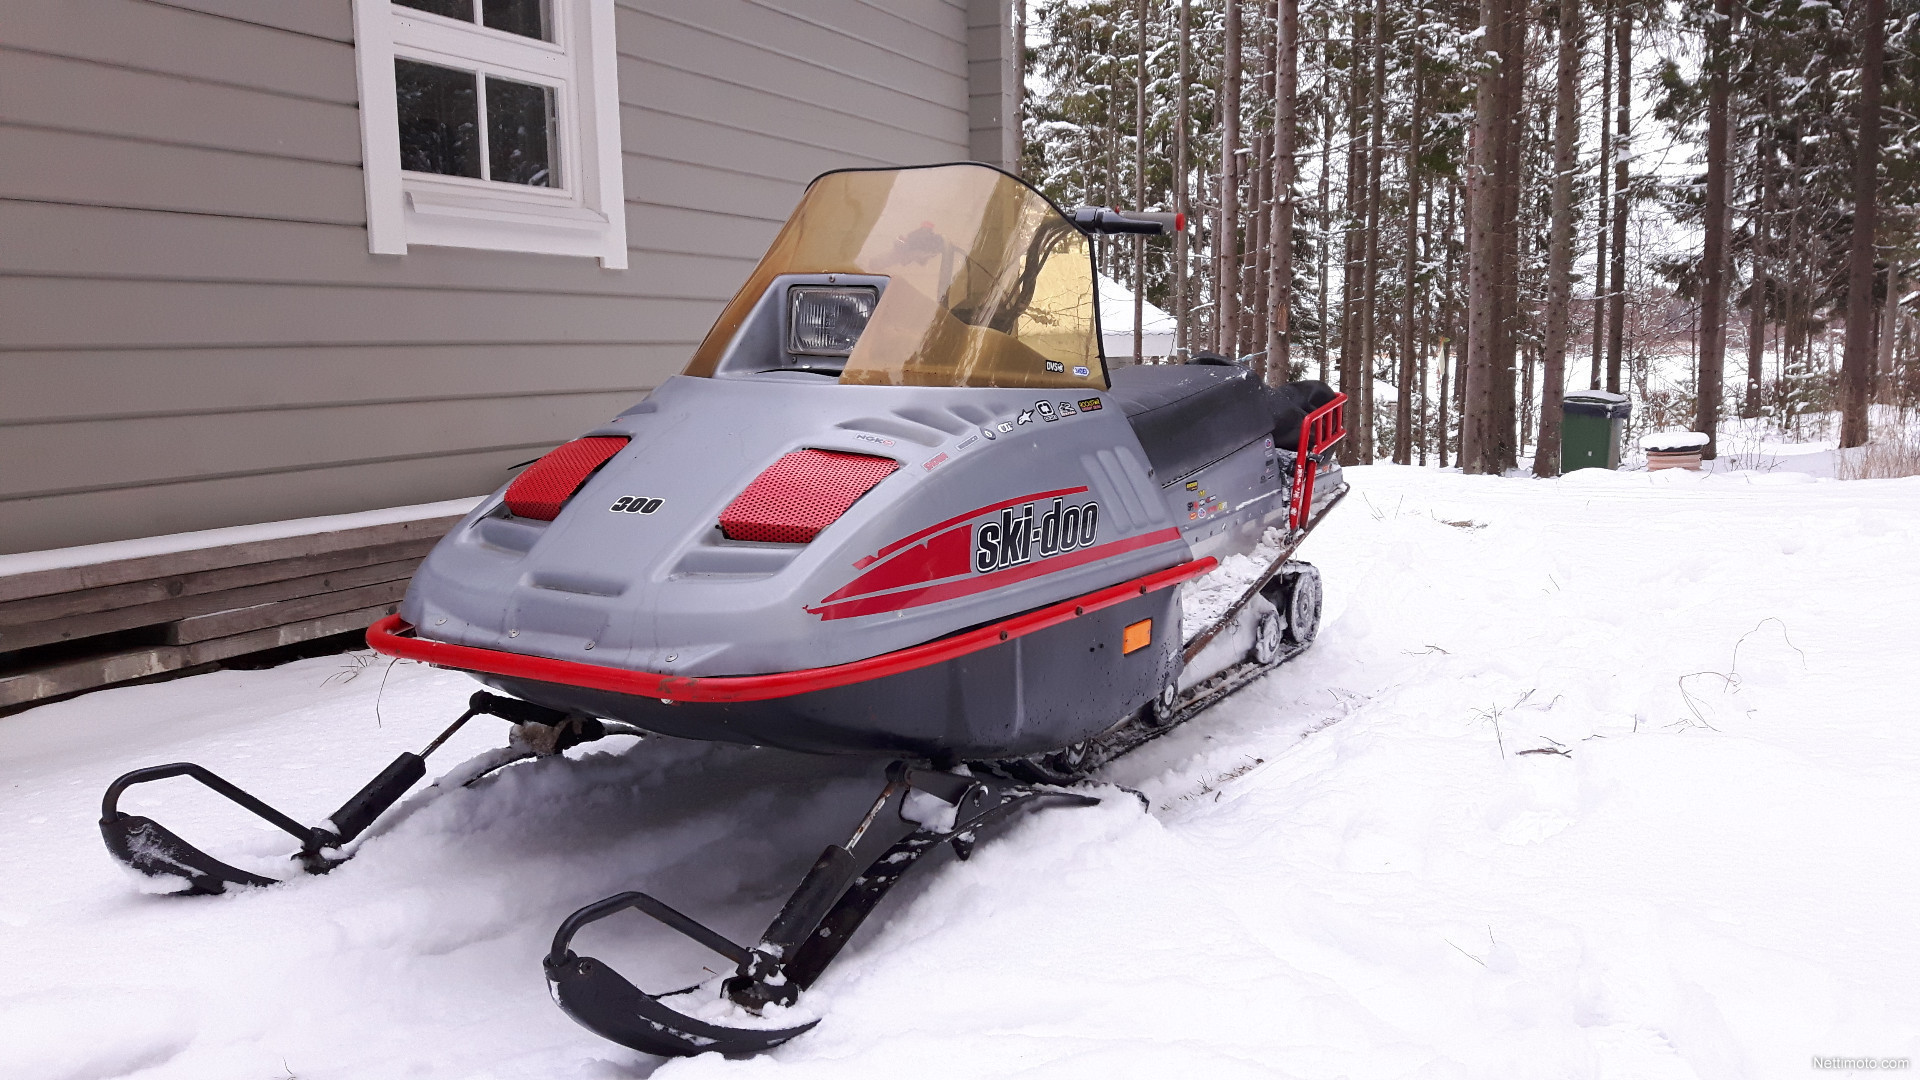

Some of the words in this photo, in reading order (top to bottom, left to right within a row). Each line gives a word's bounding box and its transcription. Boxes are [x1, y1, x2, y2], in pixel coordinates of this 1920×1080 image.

[856, 434, 884, 444] NGK
[609, 495, 665, 515] 300
[976, 498, 1099, 573] ski-doo
